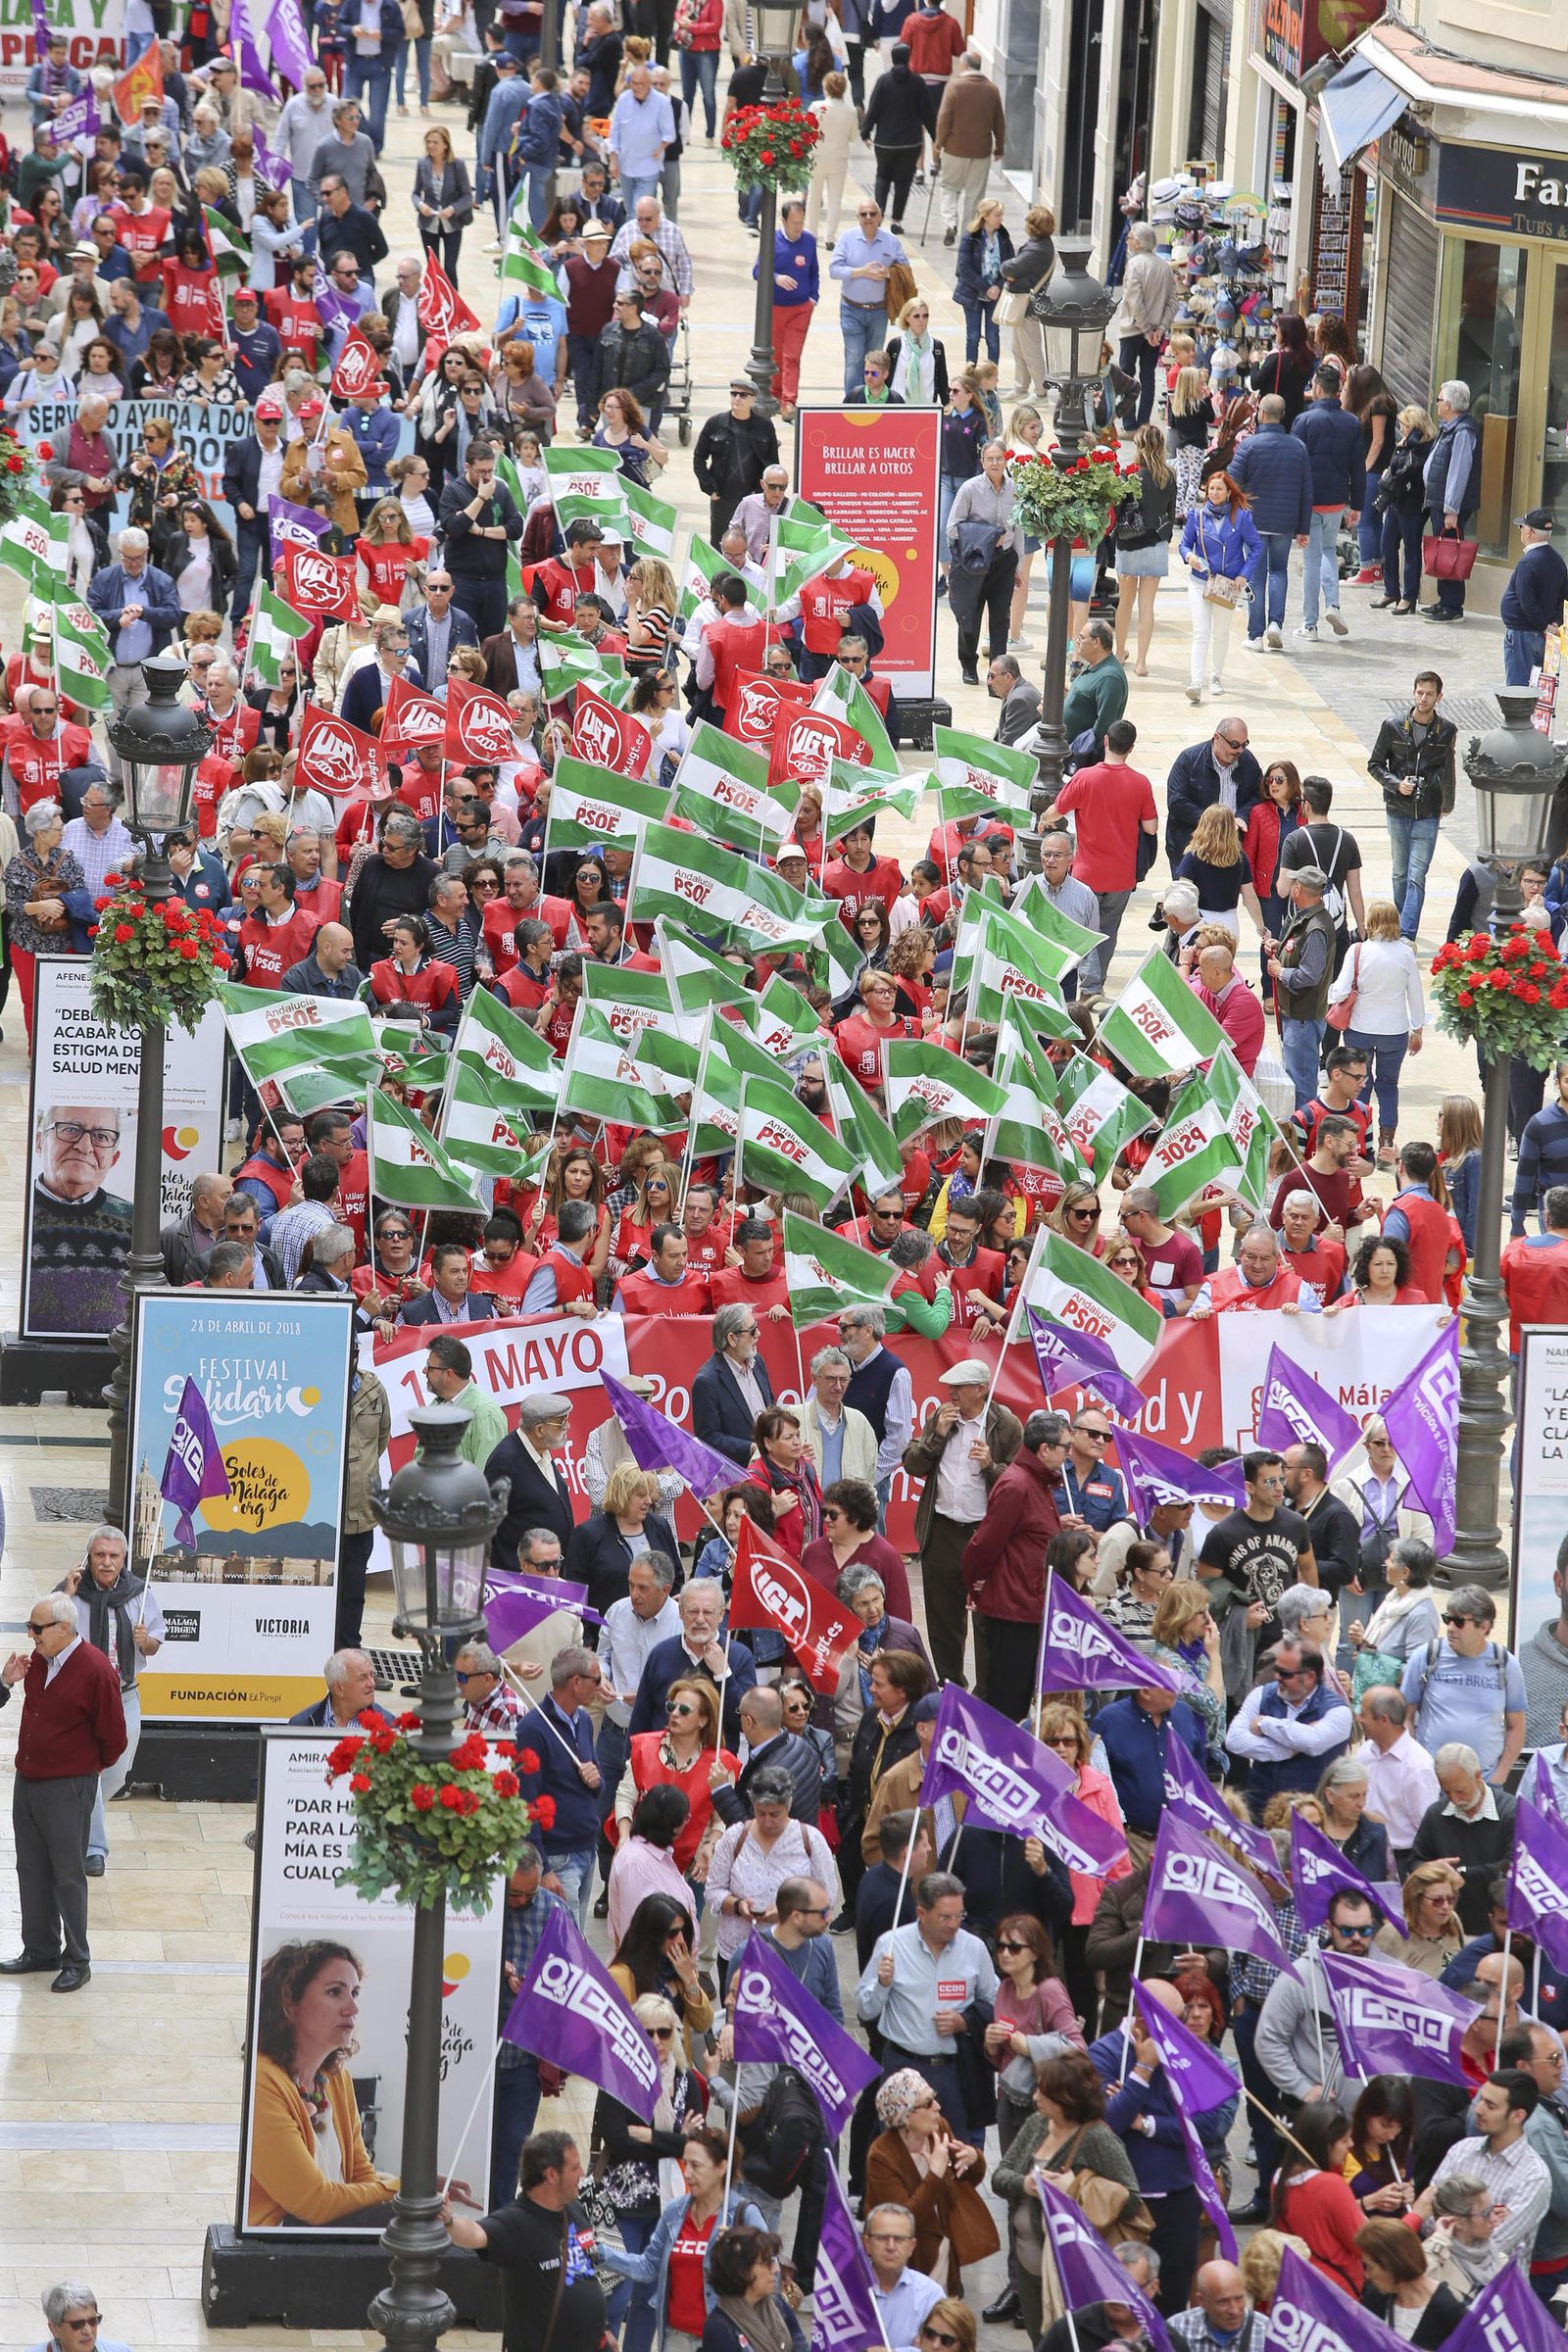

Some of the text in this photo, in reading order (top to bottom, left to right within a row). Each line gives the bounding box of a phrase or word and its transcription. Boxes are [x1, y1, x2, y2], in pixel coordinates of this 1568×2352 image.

[1514, 162, 1568, 207] Fa
[198, 406, 211, 433] A
[823, 446, 915, 460] BRILLAR ES HACER
[824, 463, 913, 474] BRILLAR A OTROS
[712, 780, 759, 814] PSOE
[580, 799, 621, 819] Andalucía
[575, 807, 620, 834] PSOE
[673, 877, 711, 906] PSOE
[254, 958, 283, 973] PSOE
[266, 997, 317, 1019] Andalucía
[1145, 998, 1176, 1036] Andalucía
[268, 1005, 322, 1034] PSOE
[1130, 1003, 1169, 1046] PSOE
[53, 1026, 116, 1040] ACABAR
[53, 1044, 119, 1057] ESTIGMA
[52, 1060, 103, 1074] SALUD
[755, 1125, 808, 1165] PSOE
[766, 1118, 810, 1155] Andalucía
[1072, 1290, 1117, 1330] Andalucía
[191, 1319, 301, 1336] 28 DE ABRIL DE 2018
[199, 1358, 289, 1382] FESTIVAL
[484, 1328, 604, 1394] MAYO
[1178, 1391, 1203, 1446] y
[1544, 1407, 1556, 1420] Y
[1543, 1446, 1563, 1459] LA
[1248, 1536, 1262, 1549] OF
[256, 1618, 310, 1634] VICTORIA
[170, 1690, 247, 1702] FUNDACIÓN
[286, 1798, 334, 1813] “DAR
[285, 1821, 335, 1836] PARA
[284, 1840, 342, 1858] MÍA ES
